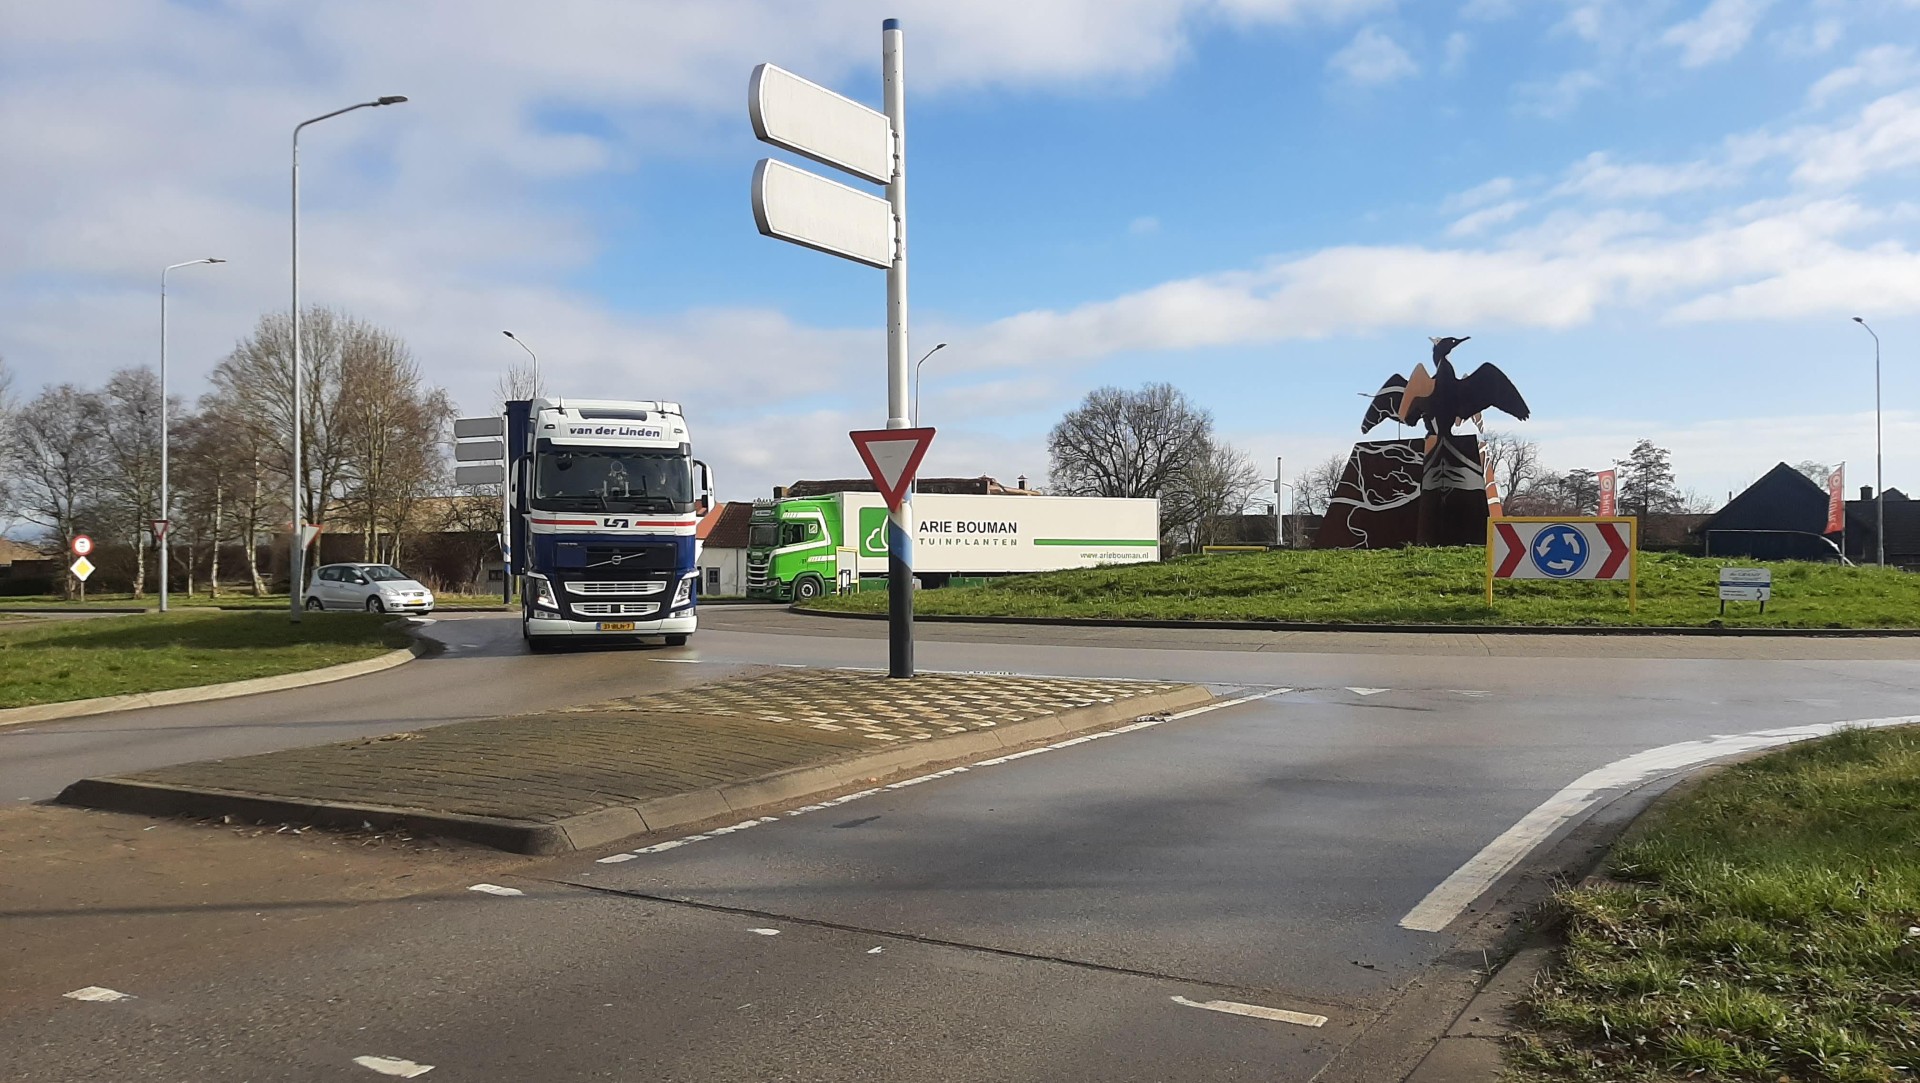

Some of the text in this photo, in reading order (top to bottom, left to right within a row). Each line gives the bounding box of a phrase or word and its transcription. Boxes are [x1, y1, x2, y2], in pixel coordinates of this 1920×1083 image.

[595, 426, 617, 435] der
[619, 427, 660, 437] Linden
[919, 521, 1017, 533] ARIE BOUMAN
[919, 538, 1017, 546] TUINPLANTEN
